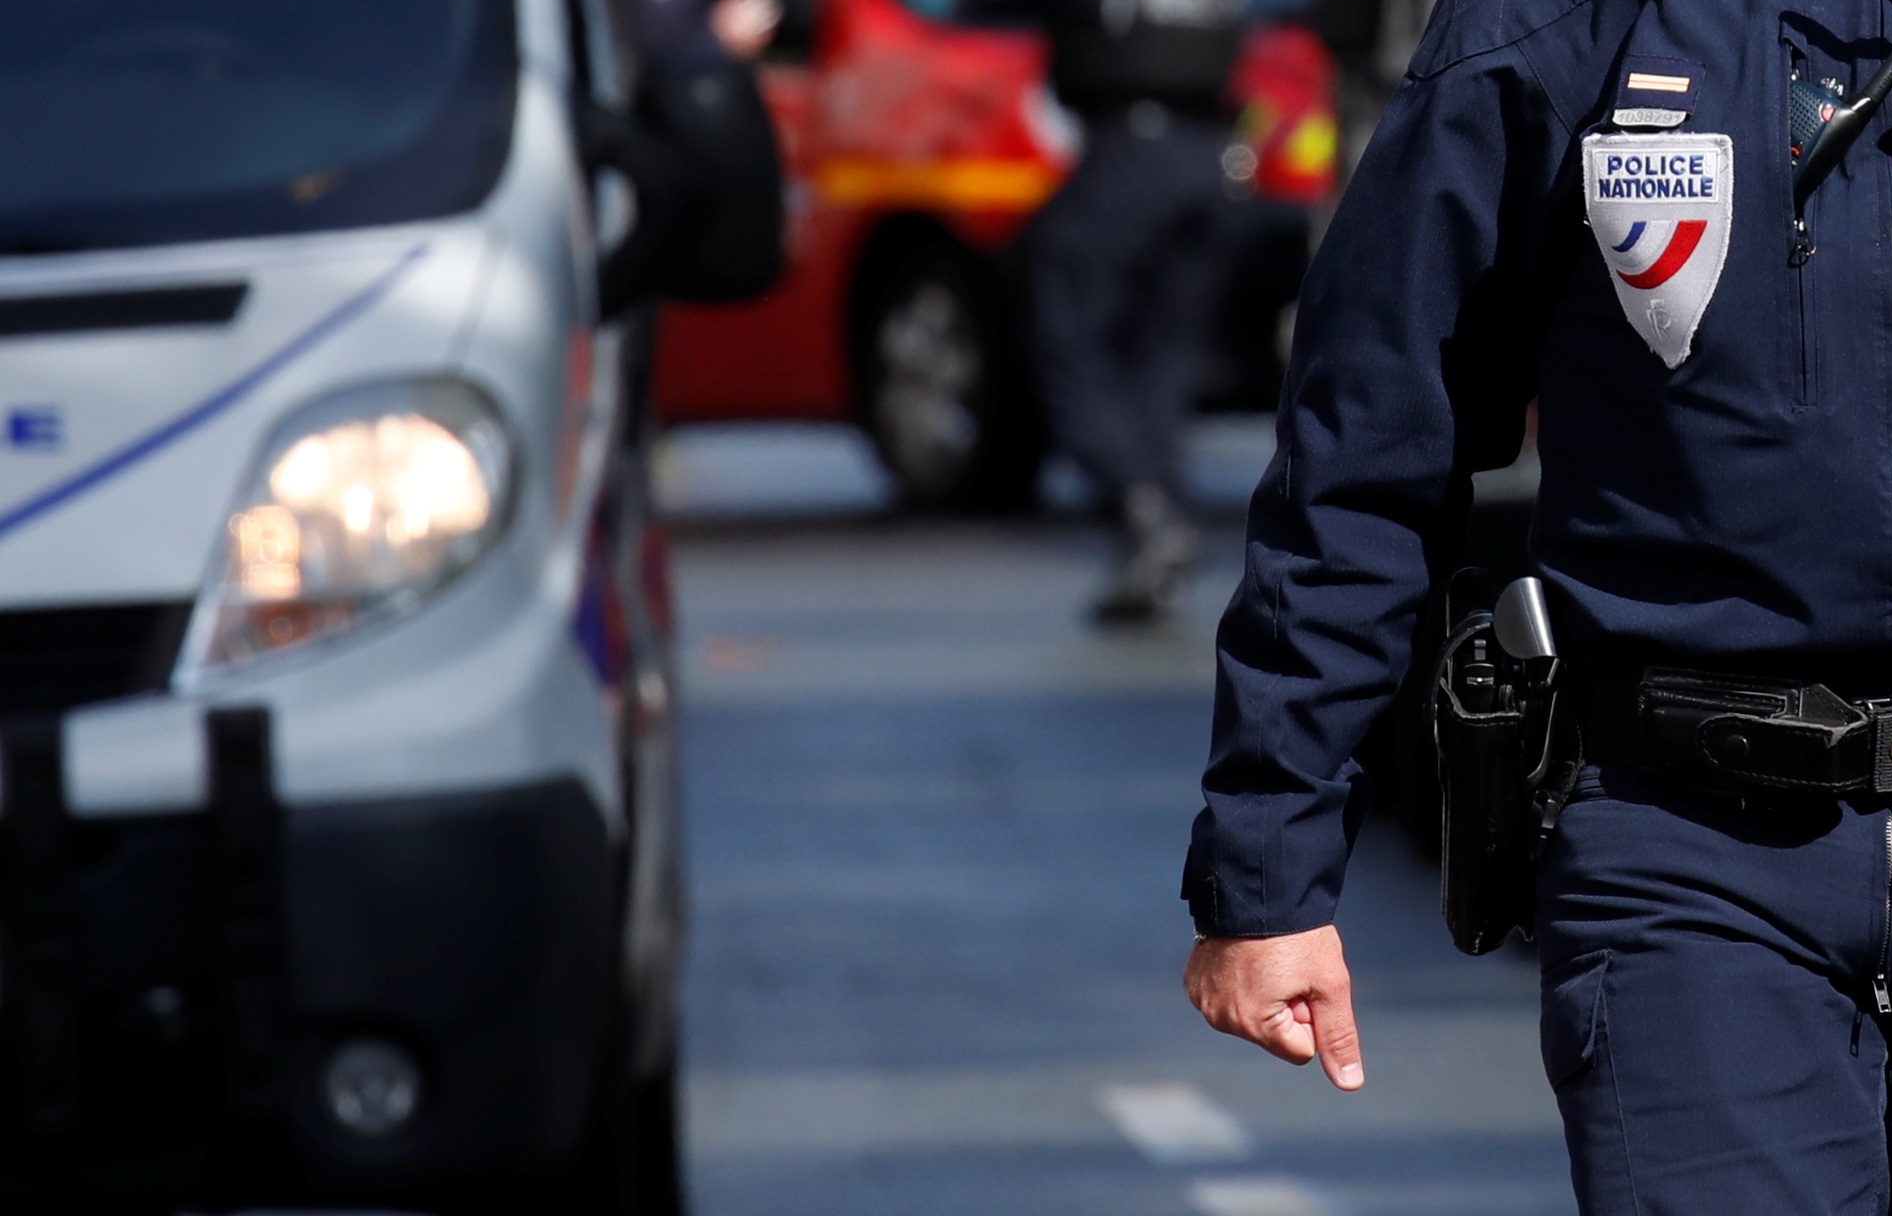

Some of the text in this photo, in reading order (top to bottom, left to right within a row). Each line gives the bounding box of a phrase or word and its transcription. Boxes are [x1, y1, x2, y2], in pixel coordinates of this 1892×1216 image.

[1618, 110, 1681, 124] 1038791
[1607, 155, 1704, 175] POLICE
[1598, 178, 1713, 198] NATIONALE
